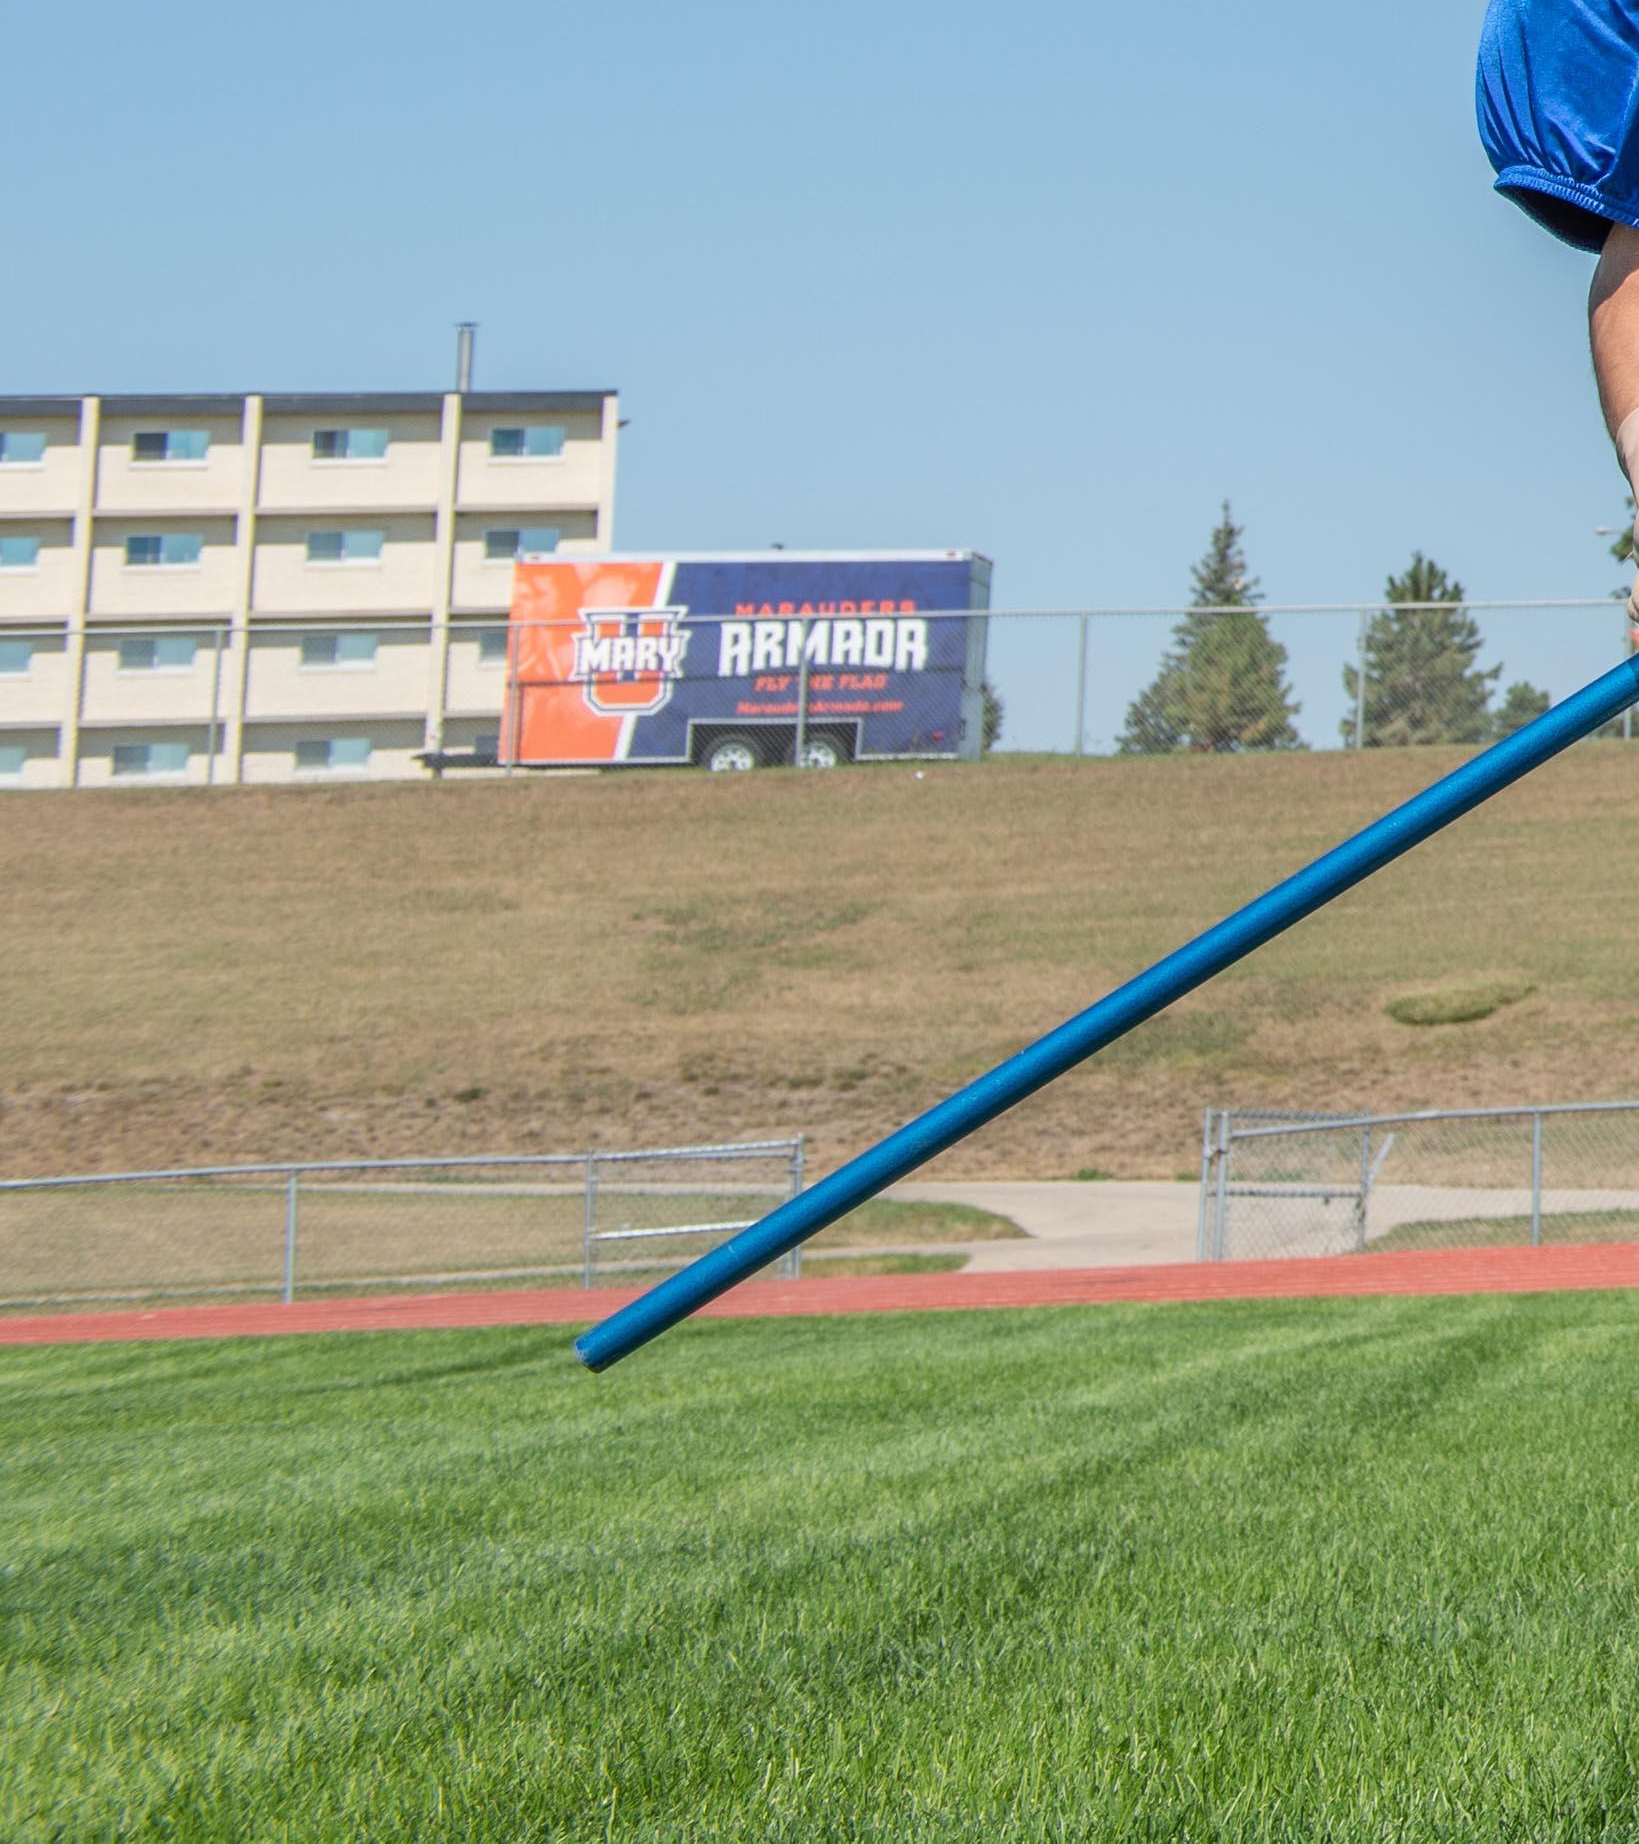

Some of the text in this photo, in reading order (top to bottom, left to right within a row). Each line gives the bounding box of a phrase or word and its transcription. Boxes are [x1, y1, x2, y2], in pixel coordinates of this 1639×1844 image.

[735, 600, 915, 617] MARAUDERS
[578, 636, 682, 674] MARY
[718, 619, 927, 676] ARMADA
[754, 674, 790, 692] FLY
[838, 672, 887, 691] FLAG
